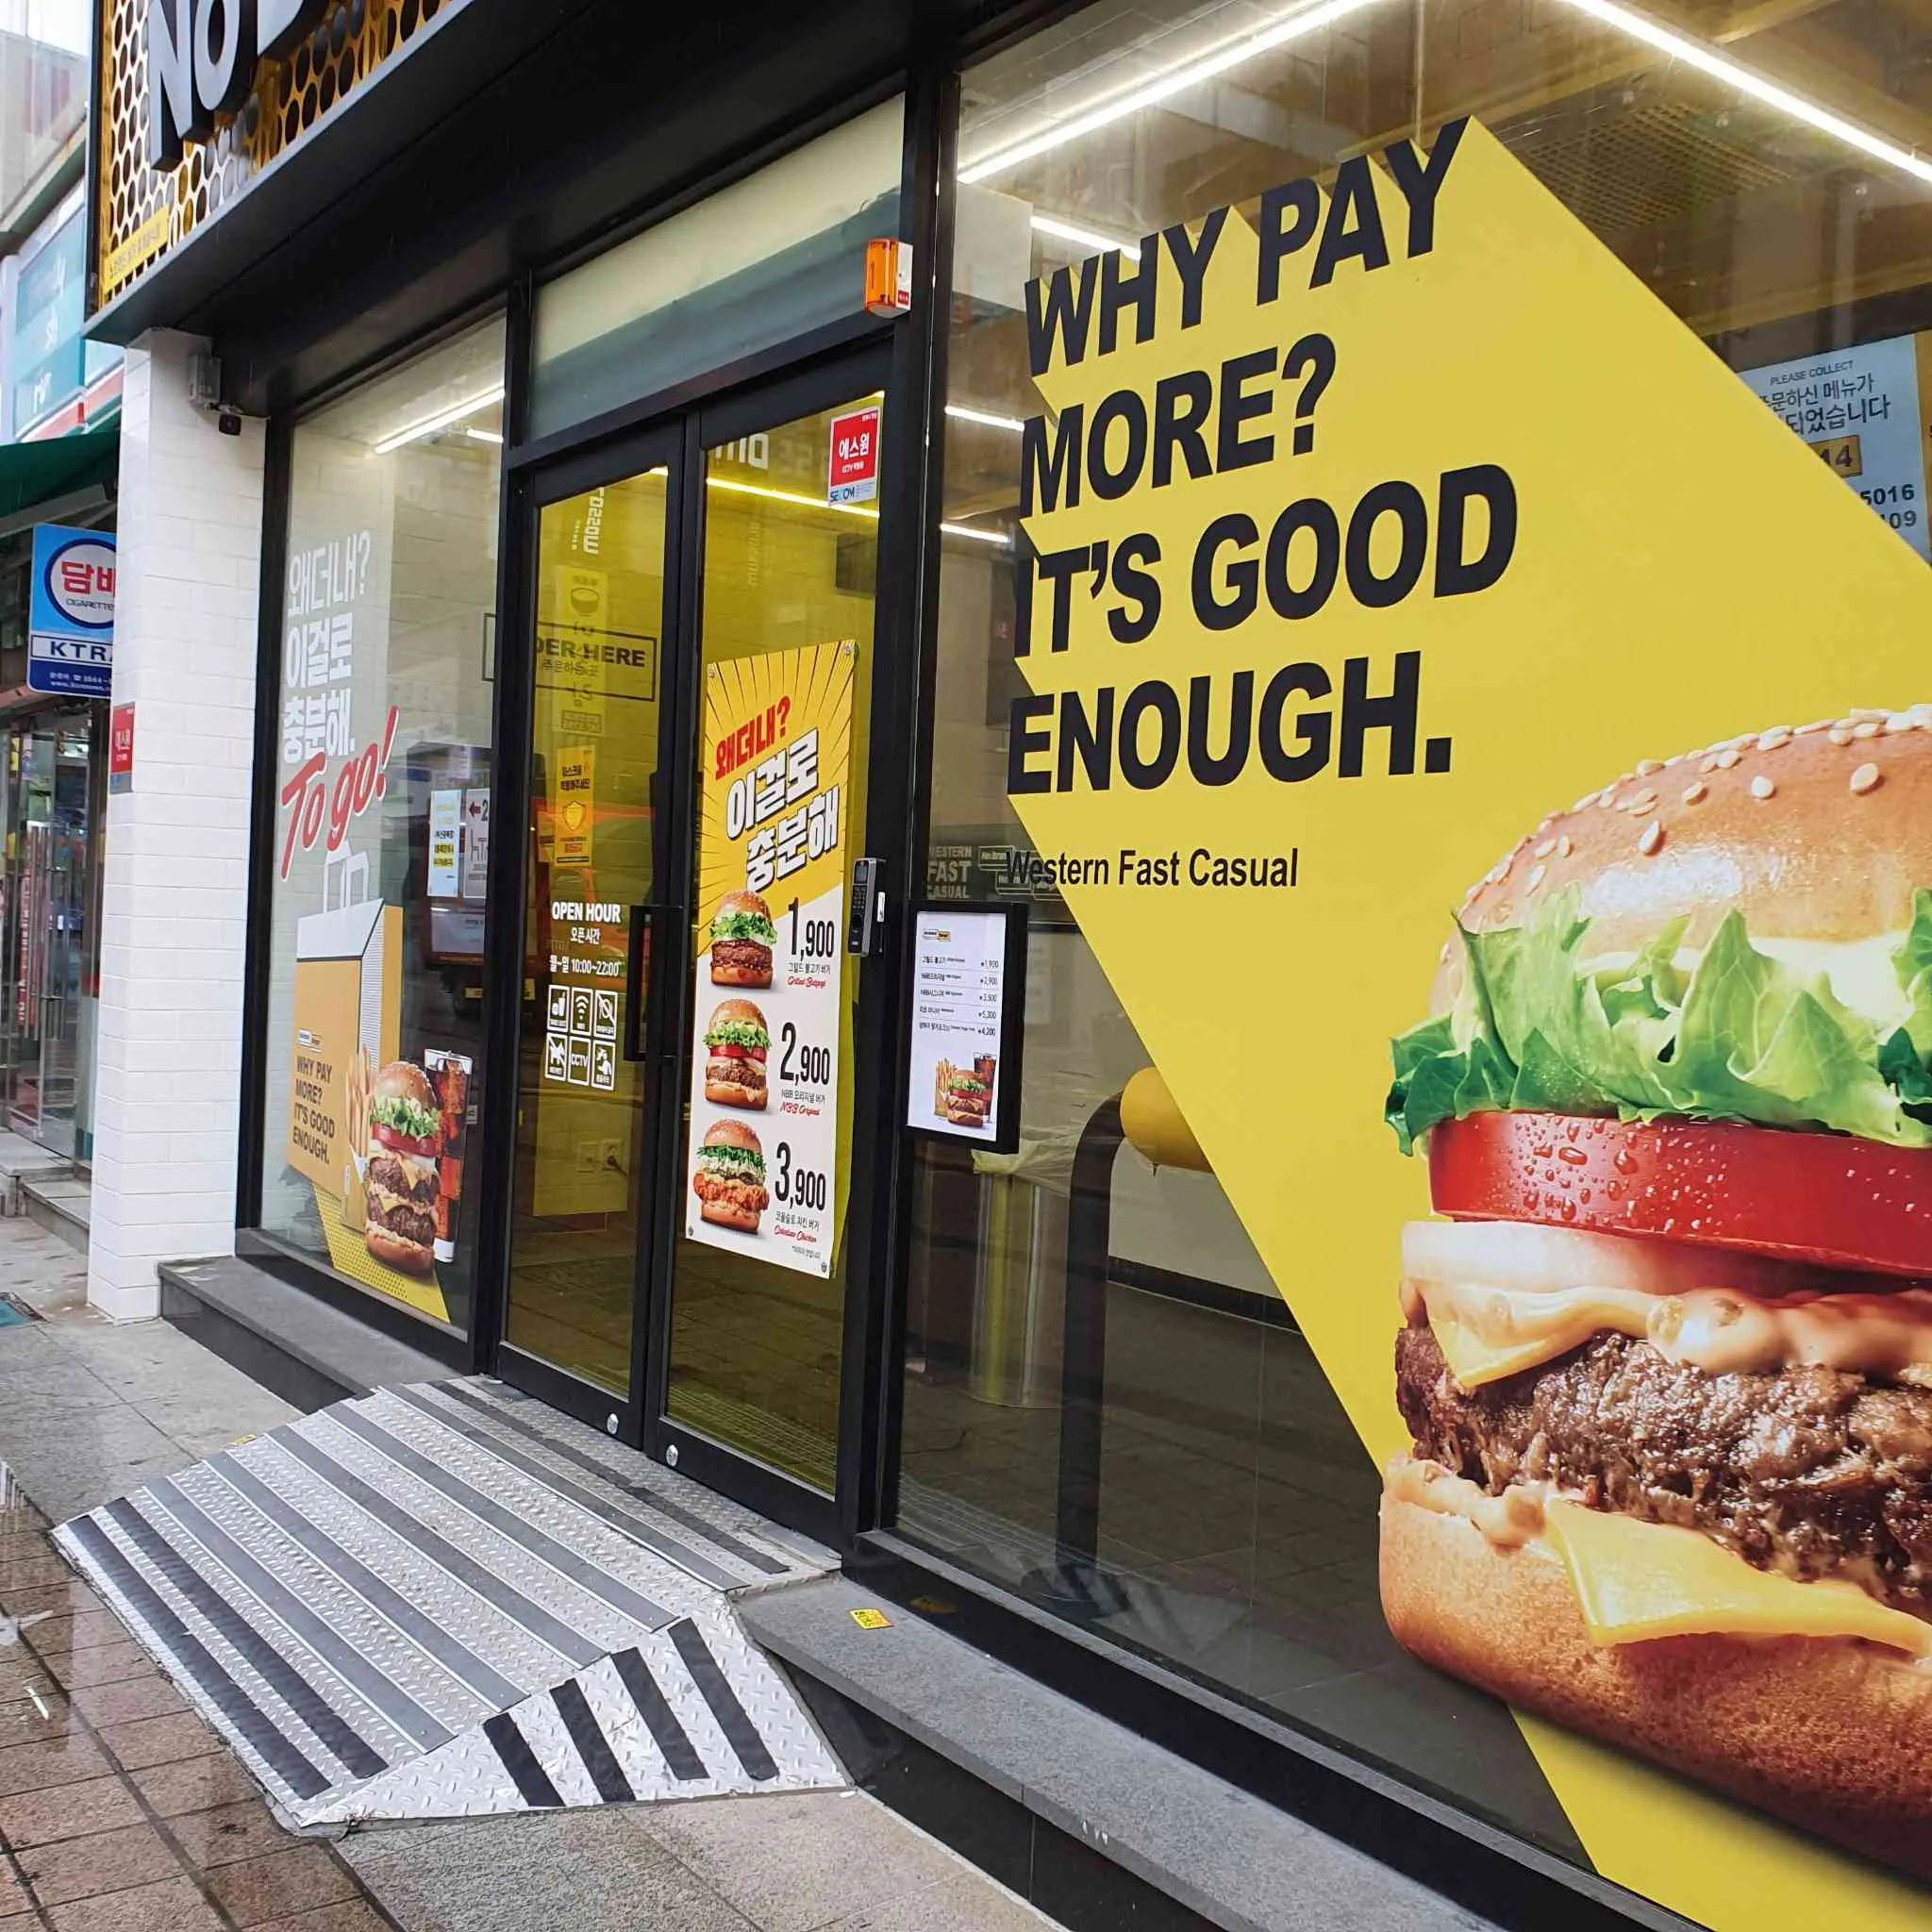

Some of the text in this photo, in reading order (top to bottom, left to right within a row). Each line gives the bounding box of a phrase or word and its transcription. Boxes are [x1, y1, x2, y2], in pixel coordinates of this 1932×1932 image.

[1024, 115, 1472, 377] WHY PAY
[1770, 360, 1854, 386] PLEASE COLLECT
[1824, 372, 1874, 400] 메뉴가
[1019, 333, 1337, 518] MORE?
[1778, 393, 1890, 435] 되었습니다
[1880, 509, 1917, 530] 09
[1015, 464, 1517, 658] IT'S GOOD
[50, 641, 112, 662] KTR
[286, 612, 353, 689] 이걸로
[582, 643, 646, 668] HERE
[1008, 651, 1452, 795] ENOUGH.
[282, 706, 399, 881] To go!
[725, 727, 819, 840] 이걸로
[746, 784, 839, 893] 충분해
[926, 860, 972, 883] FAST
[1007, 849, 1298, 887] Western Fast Casual
[552, 902, 621, 924] OPEN HOUR
[789, 897, 835, 961] 1,900
[571, 958, 620, 977] 10:00~22:00
[296, 1056, 332, 1084] WHY PAY
[571, 1053, 589, 1068] CCTV
[780, 1023, 831, 1086] 2,900
[295, 1078, 323, 1105] MORE?
[309, 1109, 335, 1139] GOOD
[292, 1125, 329, 1164] ENOUGH.
[775, 1141, 825, 1210] 3,900
